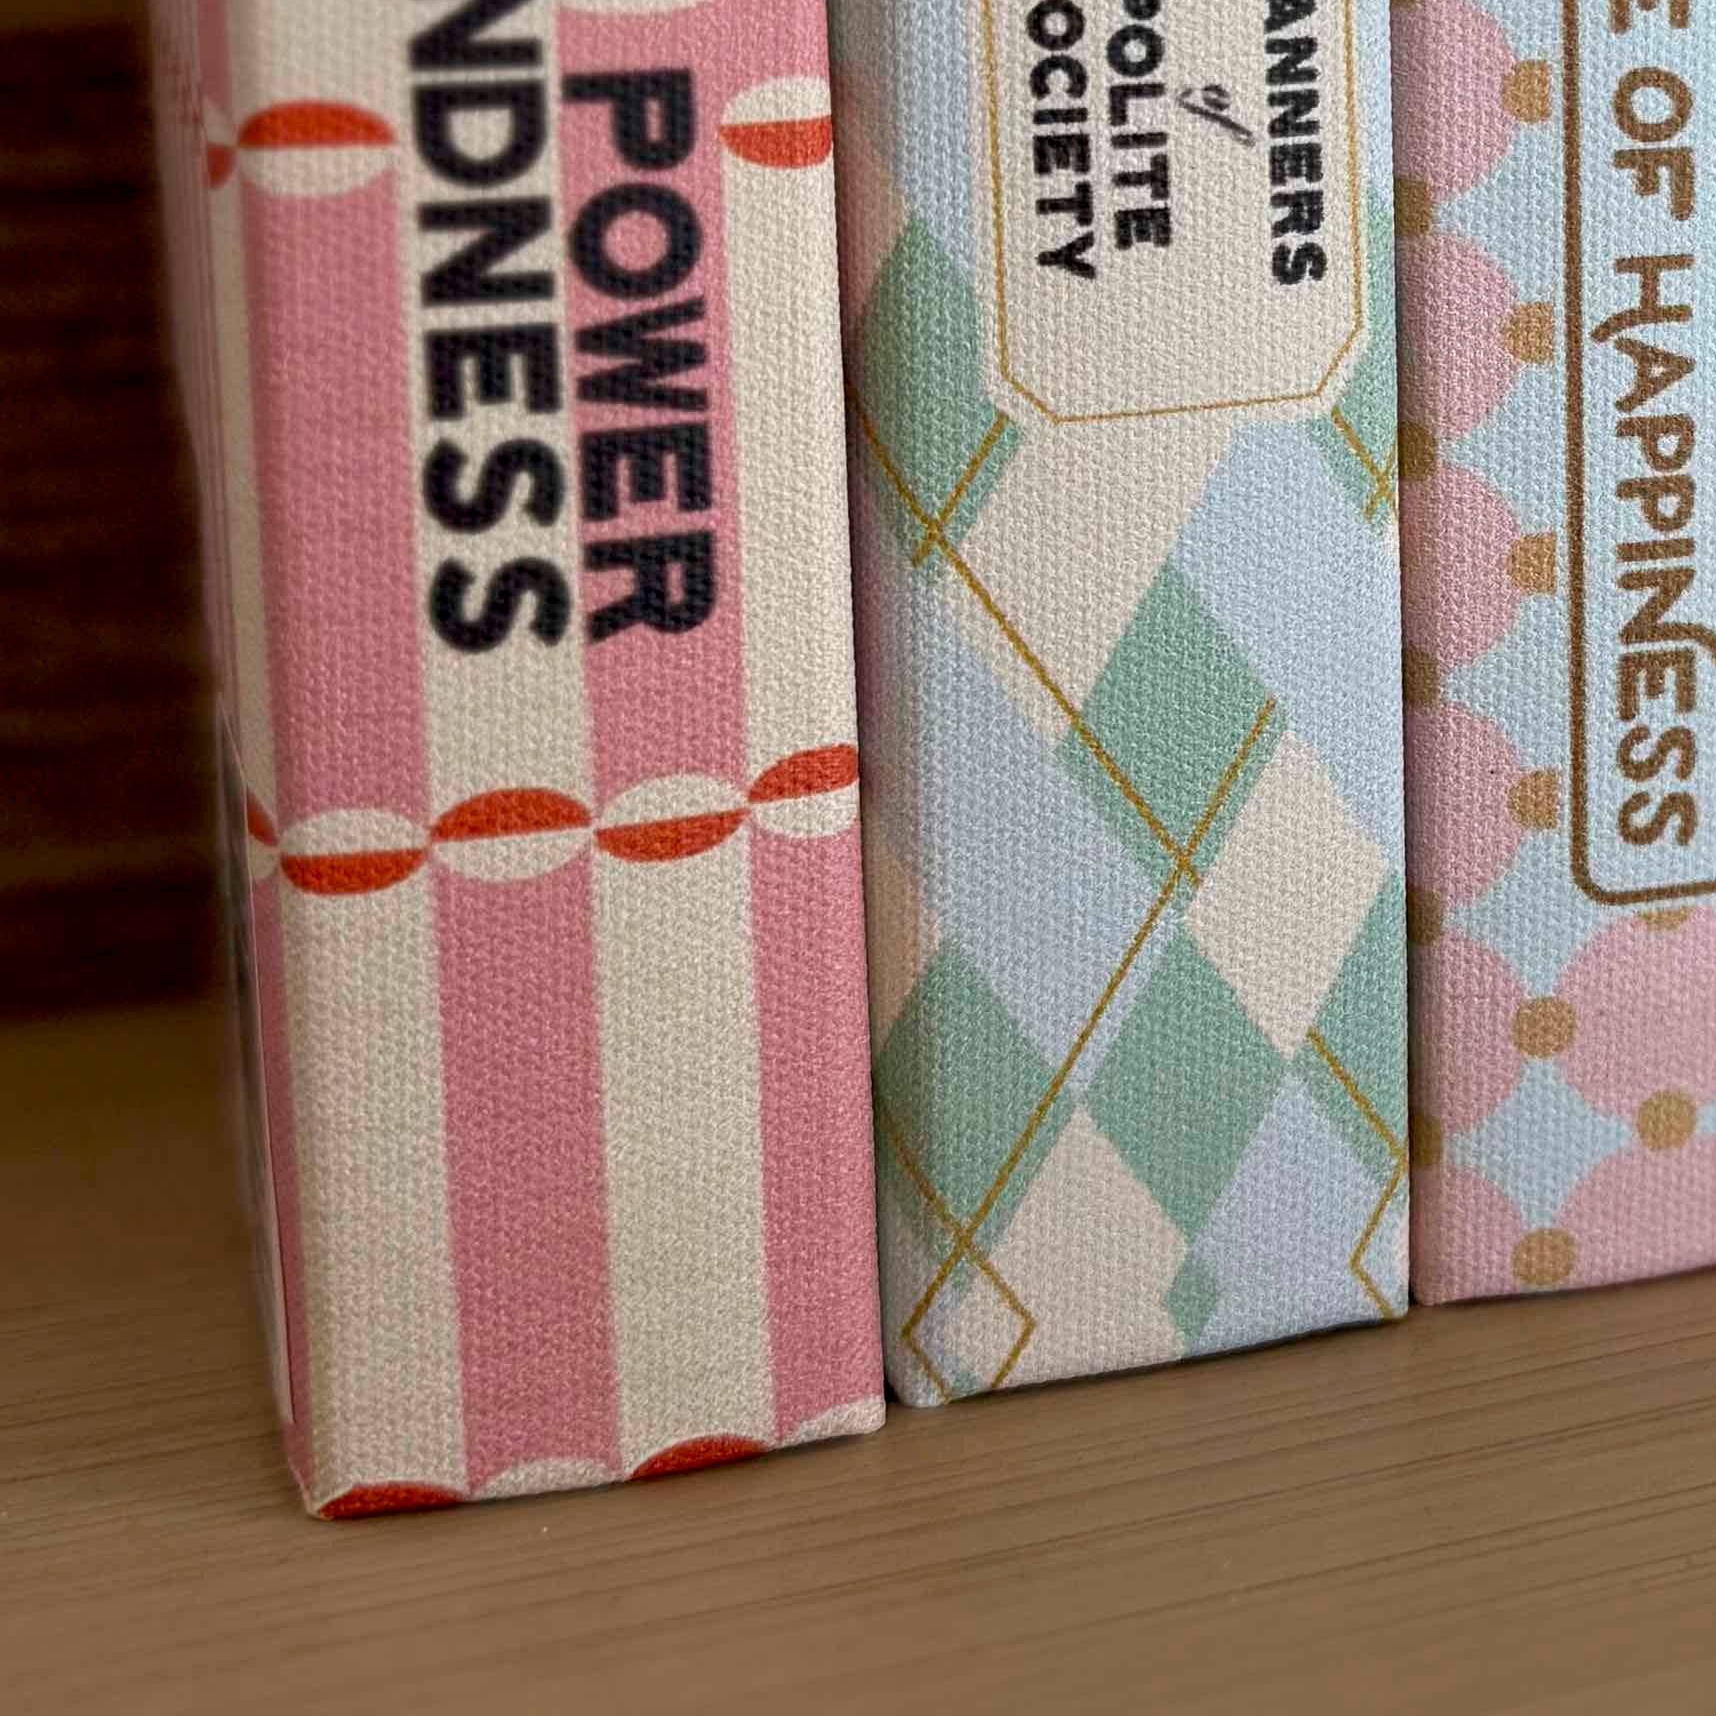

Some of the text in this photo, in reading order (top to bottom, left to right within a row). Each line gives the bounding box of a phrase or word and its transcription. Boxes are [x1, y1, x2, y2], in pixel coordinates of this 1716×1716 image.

[1174, 83, 1255, 148] of
[1611, 65, 1695, 223] OF
[561, 68, 716, 645] POWER
